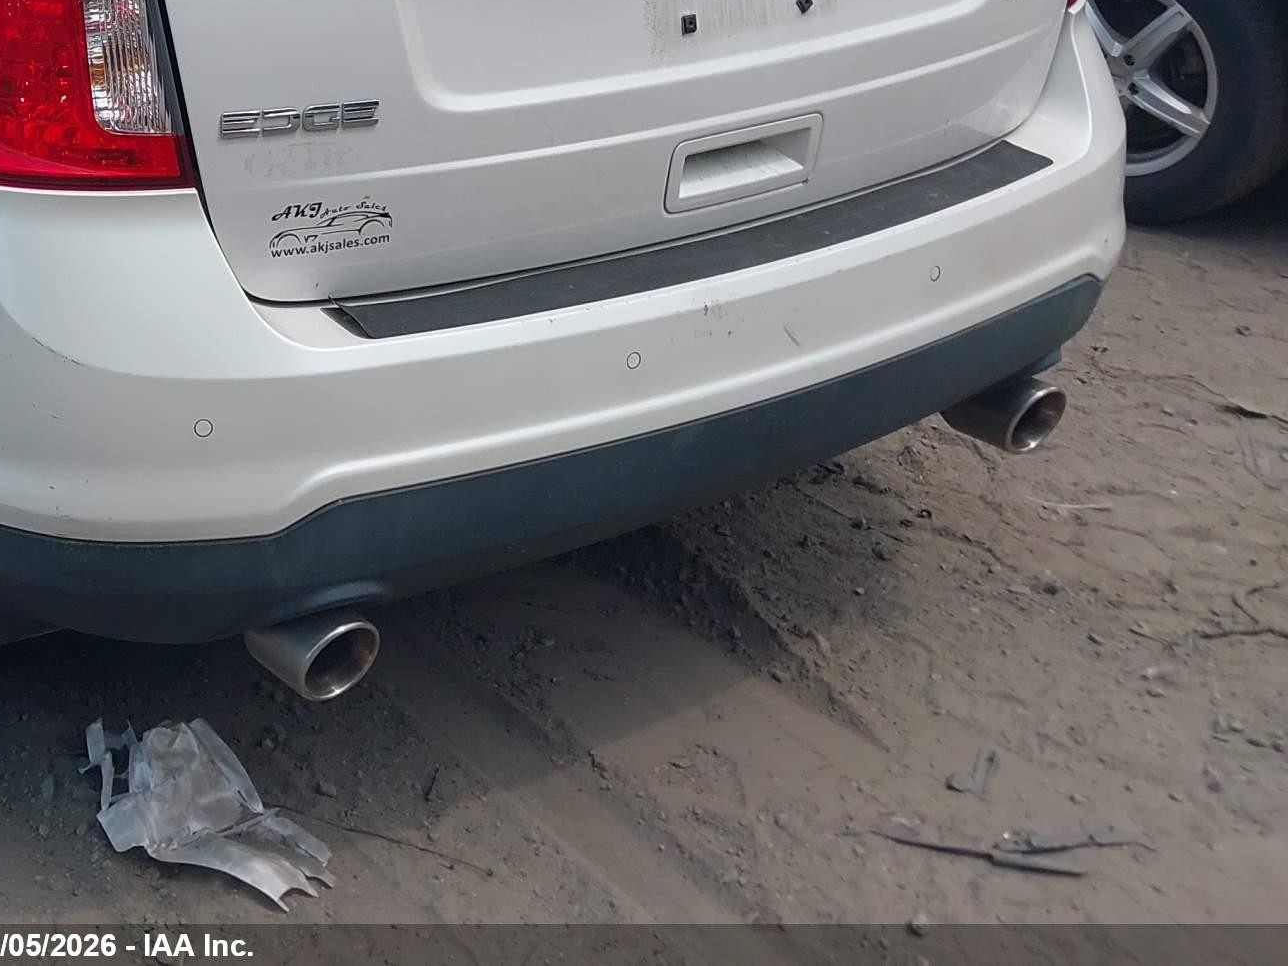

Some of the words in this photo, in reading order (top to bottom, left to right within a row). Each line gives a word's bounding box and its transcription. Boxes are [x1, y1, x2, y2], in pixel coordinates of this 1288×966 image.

[220, 100, 379, 139] EDGE
[271, 202, 323, 221] AKJ
[319, 205, 352, 219] Auto
[355, 201, 387, 212] Sales
[271, 234, 390, 258] www.akjsales.com
